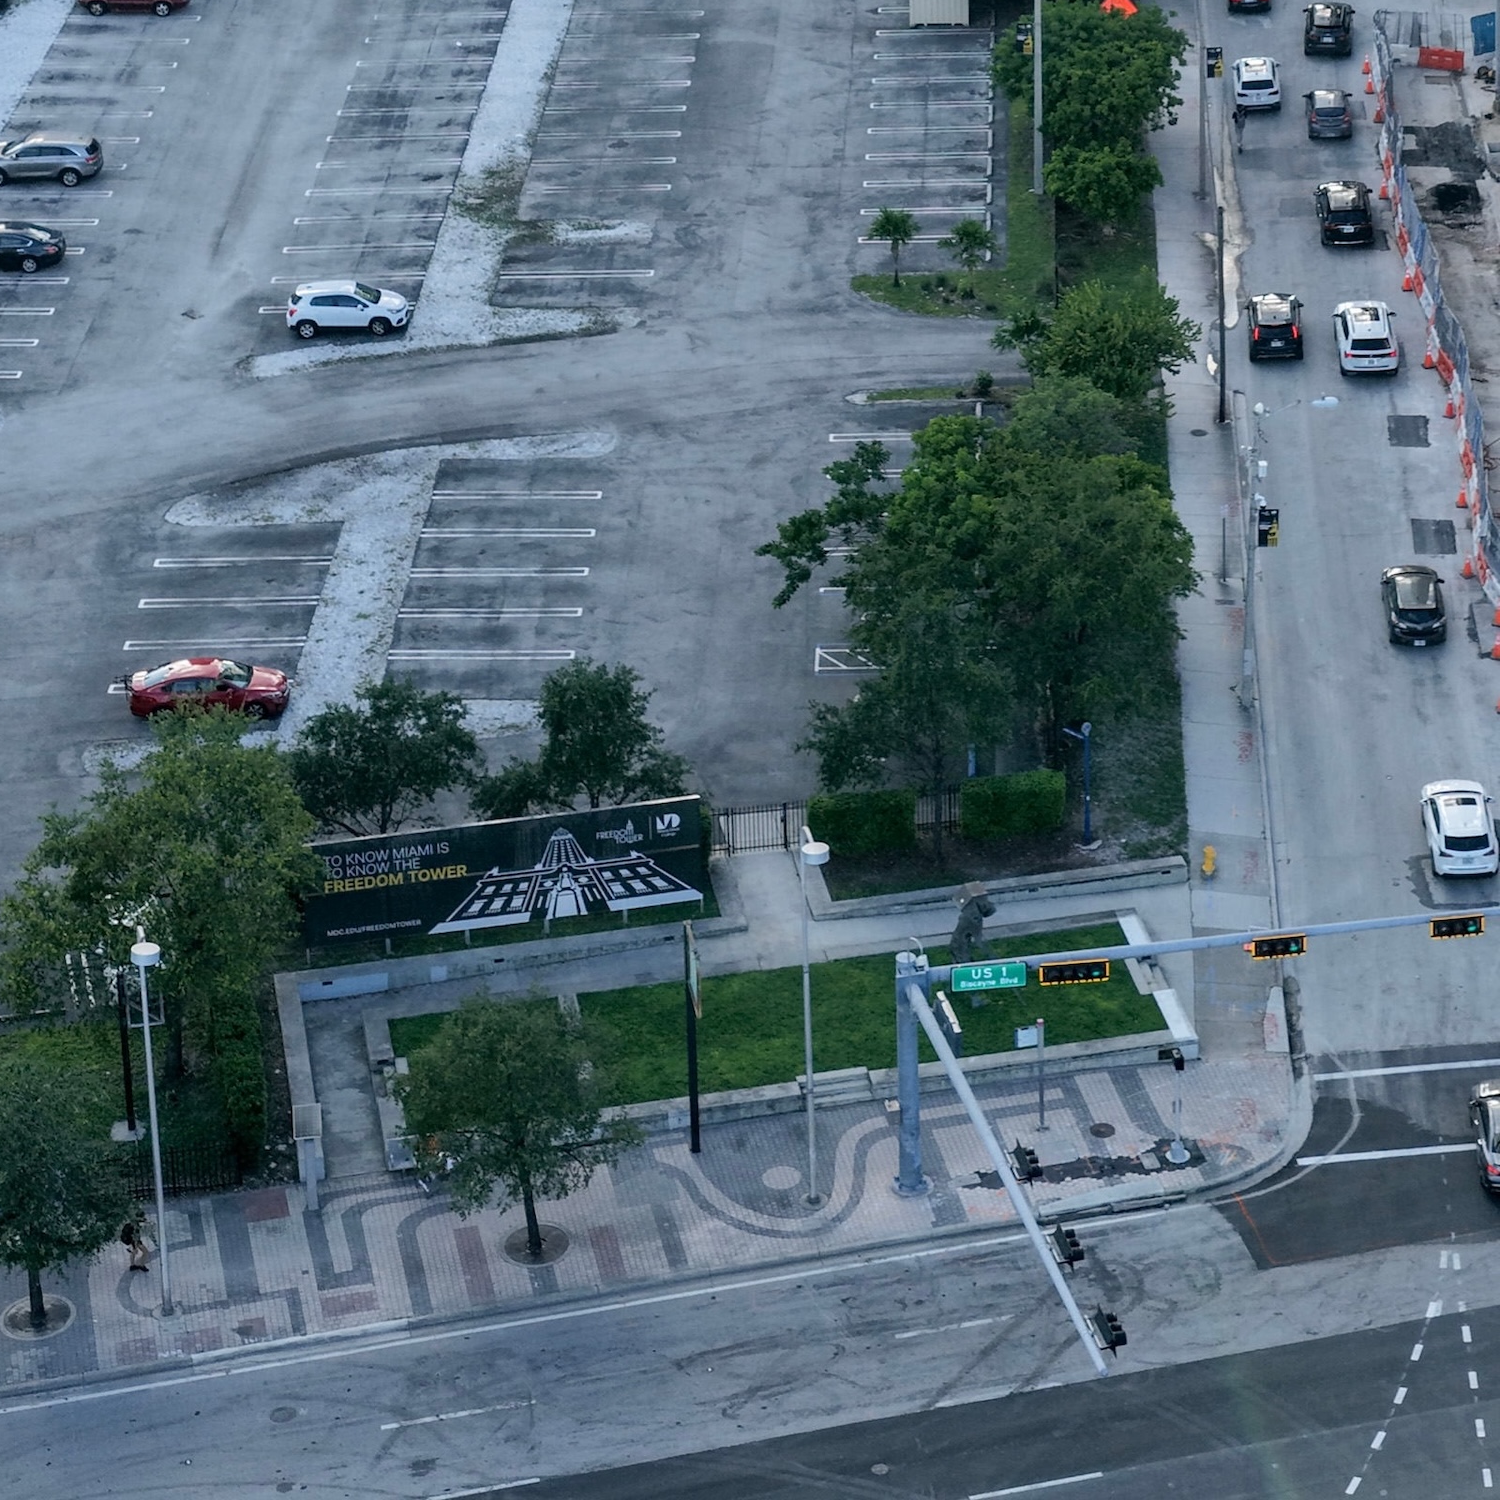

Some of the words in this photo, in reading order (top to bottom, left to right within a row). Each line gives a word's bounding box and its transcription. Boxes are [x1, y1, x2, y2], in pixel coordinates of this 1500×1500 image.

[323, 855, 342, 867] TO
[346, 850, 389, 865] KNOW
[393, 843, 433, 858] MIAMI
[437, 842, 450, 854] IS
[346, 861, 390, 877] KNOW
[394, 857, 421, 871] THE
[324, 873, 404, 894] FREEDOM
[407, 865, 467, 883] TOWER
[327, 920, 421, 936] MDC.EDU/FREEDOMTOWER
[971, 968, 992, 979] US
[1001, 966, 1007, 977] 1
[960, 980, 997, 988] Biscayne
[1000, 977, 1018, 985] Blvd
